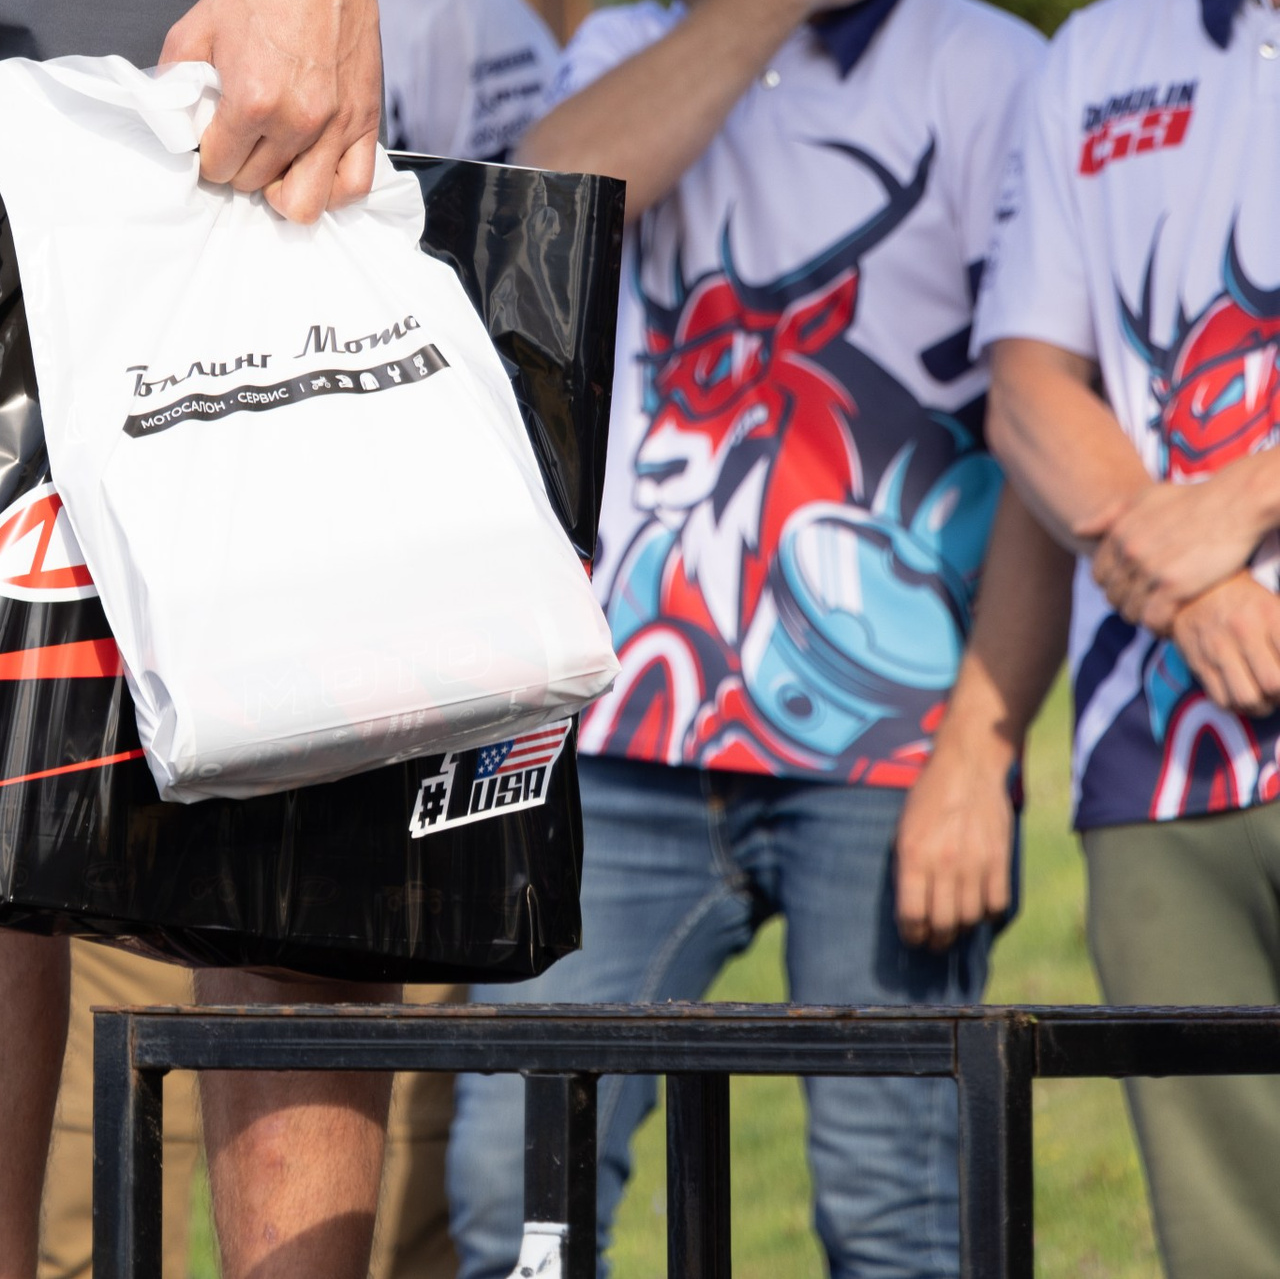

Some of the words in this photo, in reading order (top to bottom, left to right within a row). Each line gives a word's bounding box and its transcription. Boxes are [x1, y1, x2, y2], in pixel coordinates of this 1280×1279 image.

[140, 400, 226, 429] МОТОСАЛОН
[237, 388, 290, 404] СЕРВИС
[470, 765, 547, 814] USA
